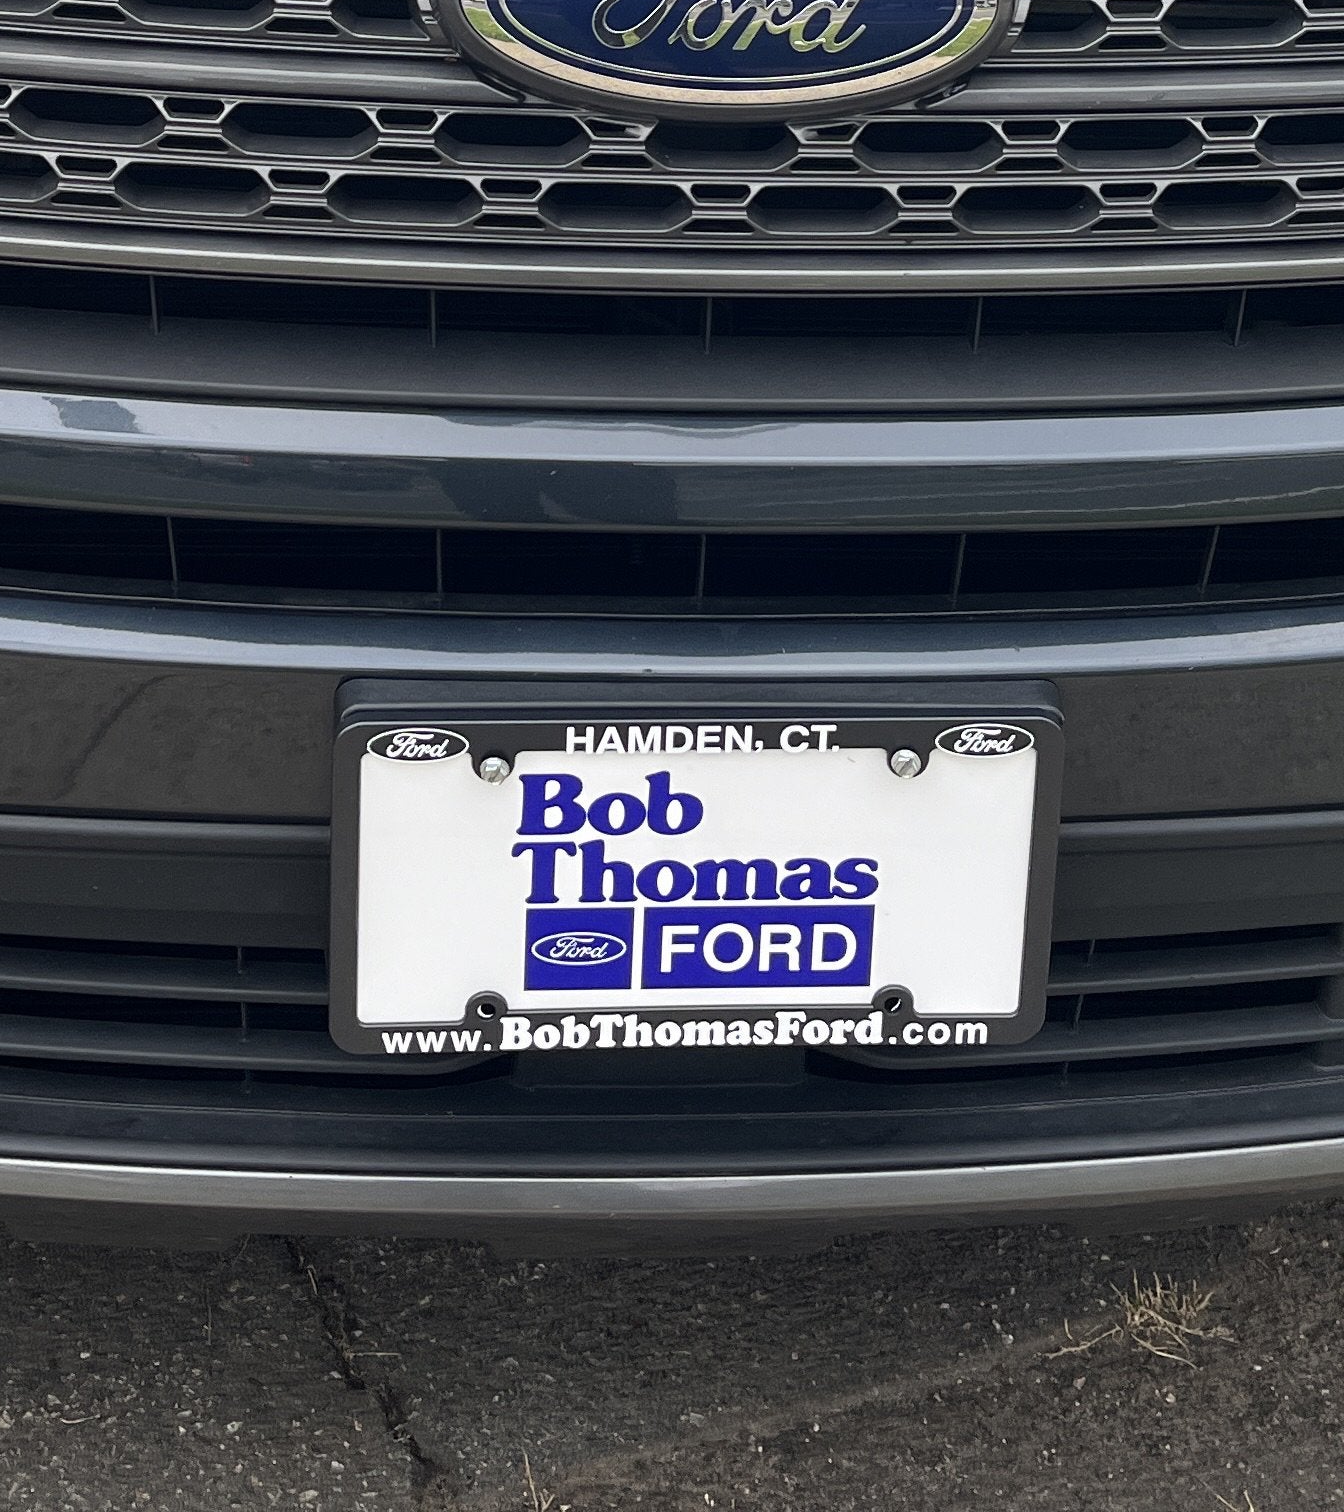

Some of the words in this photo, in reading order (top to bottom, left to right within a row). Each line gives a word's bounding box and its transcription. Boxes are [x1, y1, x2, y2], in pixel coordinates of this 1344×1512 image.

[385, 732, 450, 758] Ford
[565, 725, 764, 755] HAMDEN,
[779, 724, 841, 754] CT.
[953, 727, 1017, 753] Ford
[516, 771, 705, 838] Bob
[511, 838, 880, 905] Thomas
[549, 936, 608, 960] Ford
[659, 922, 858, 973] FORD
[381, 1010, 989, 1054] www.BobThomasFord.com
